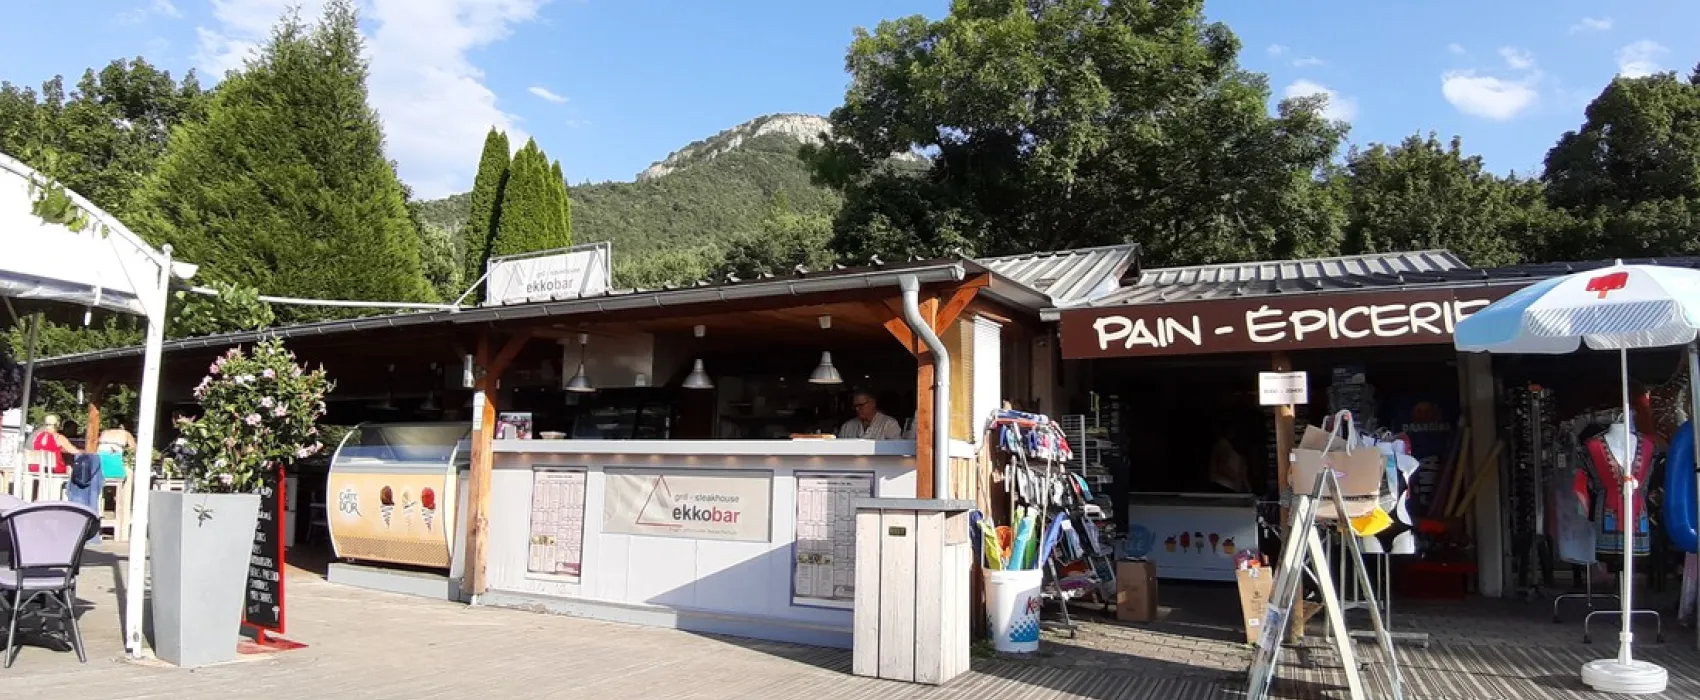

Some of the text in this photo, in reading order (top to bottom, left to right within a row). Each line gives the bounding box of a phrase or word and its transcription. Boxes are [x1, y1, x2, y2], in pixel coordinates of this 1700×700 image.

[526, 278, 573, 293] ekkobar
[1094, 315, 1202, 349] PAIN
[1215, 325, 1235, 335] -
[695, 494, 739, 502] steakhouse
[673, 504, 740, 523] ekkobar
